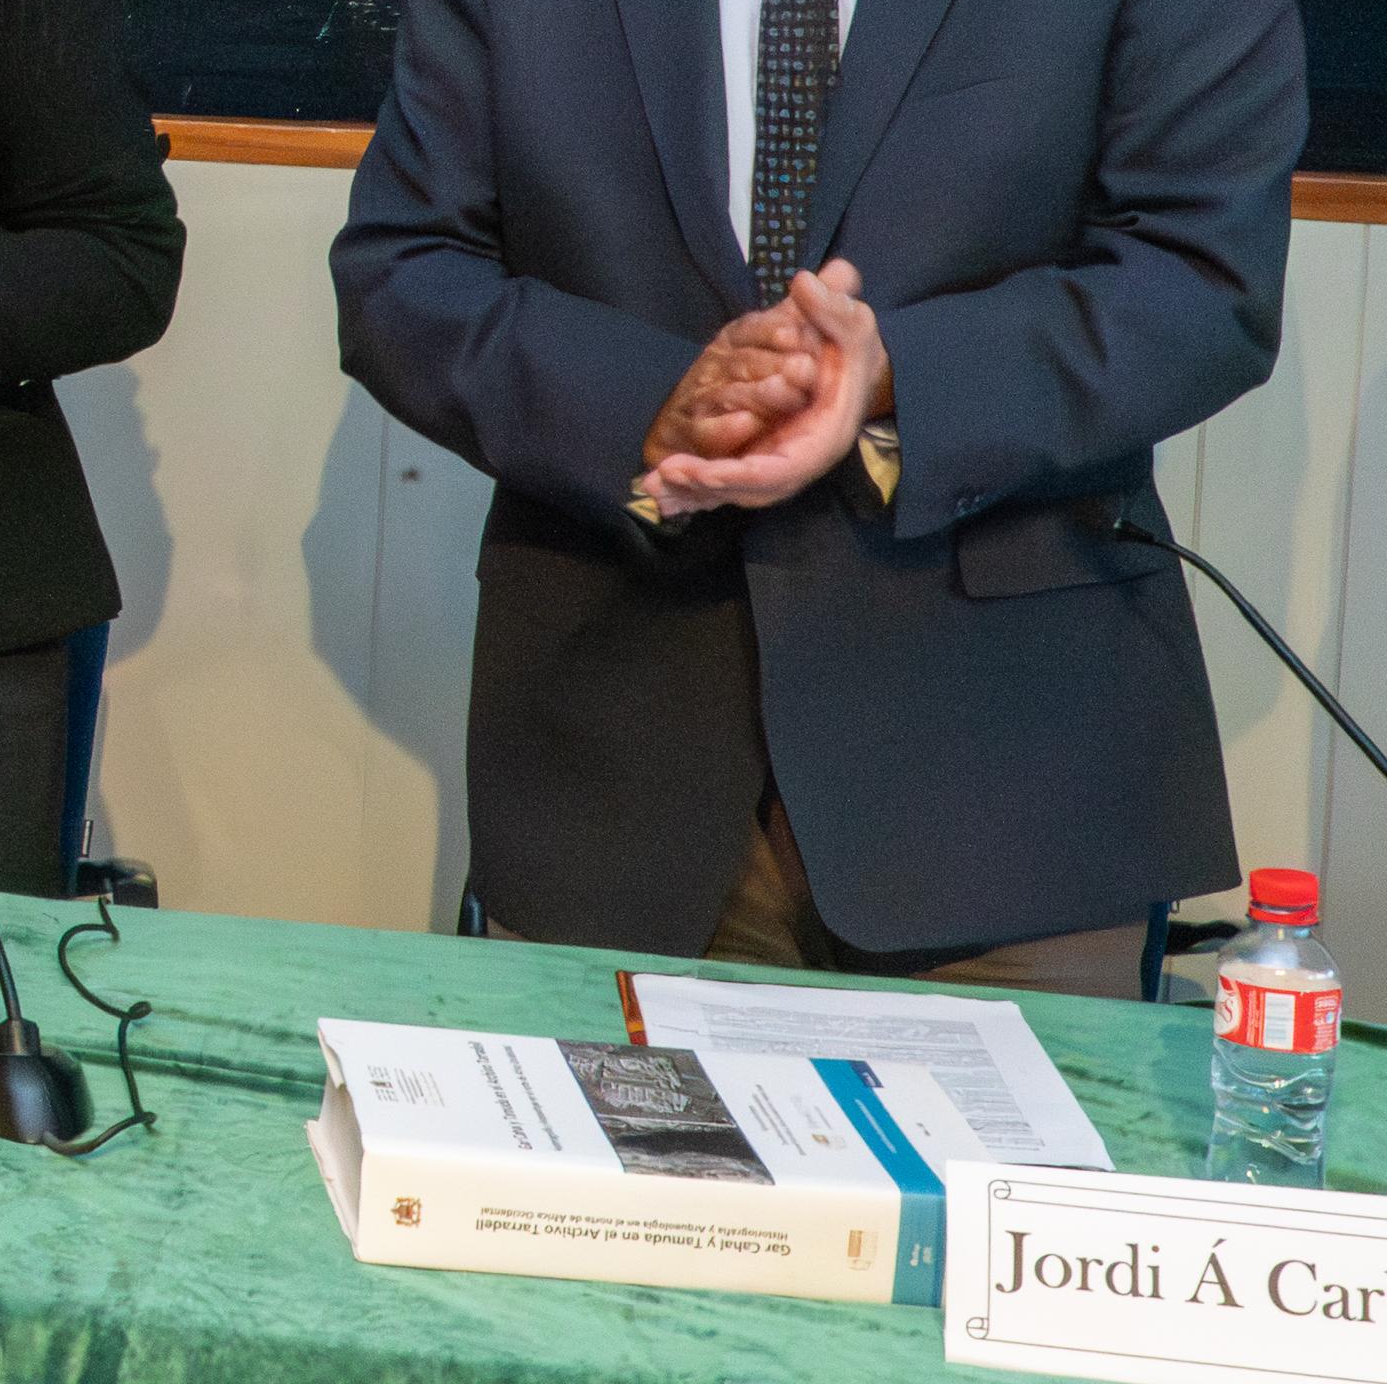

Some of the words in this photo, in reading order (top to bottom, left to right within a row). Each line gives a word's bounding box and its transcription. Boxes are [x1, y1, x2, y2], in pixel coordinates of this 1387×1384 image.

[475, 1218, 539, 1235] Tarradell
[544, 1224, 600, 1240] Archivo
[604, 1229, 618, 1242] el
[622, 1231, 640, 1241] en
[644, 1232, 702, 1249] Tamuda
[707, 1236, 716, 1248] y
[720, 1239, 761, 1254] Cahal
[765, 1243, 791, 1256] Gar
[994, 1229, 1165, 1301] Jordi
[1184, 1237, 1245, 1309] Á
[1267, 1259, 1387, 1324] Car
